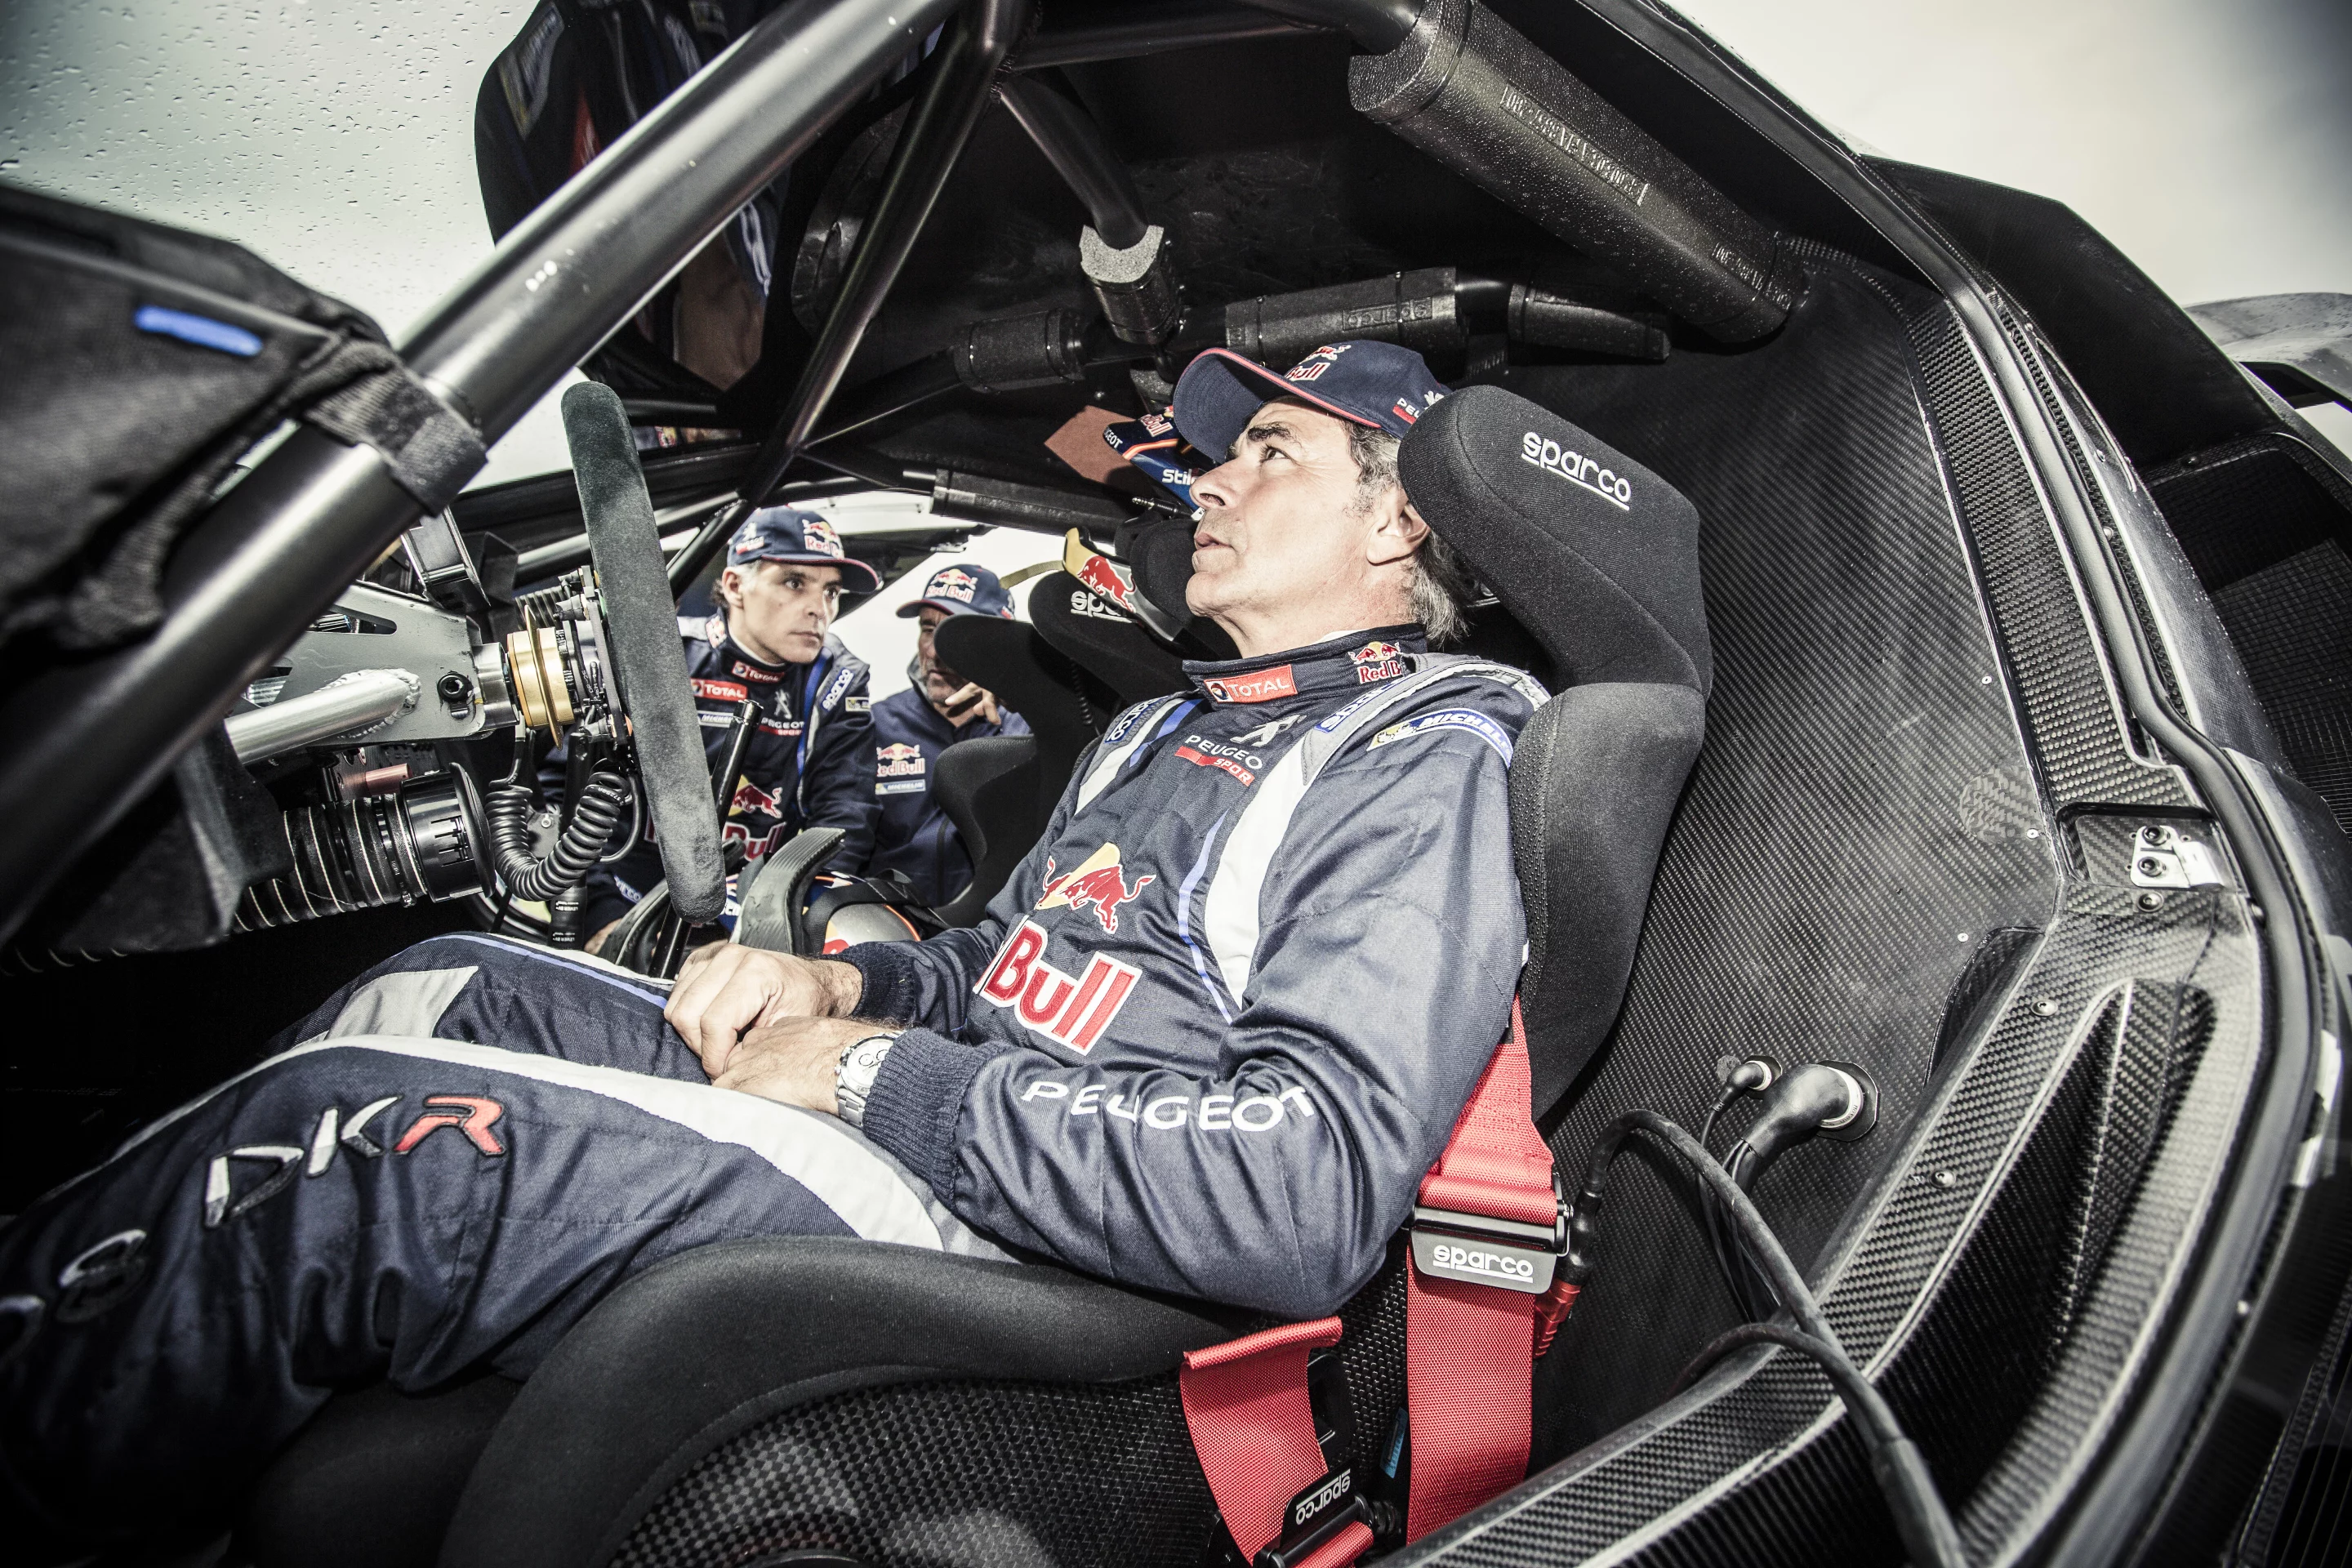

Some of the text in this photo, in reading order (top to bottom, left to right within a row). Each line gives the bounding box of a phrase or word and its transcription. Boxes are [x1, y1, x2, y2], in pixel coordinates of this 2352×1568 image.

[1521, 432, 1631, 510] sparco
[925, 584, 974, 604] Red Bull
[822, 668, 855, 711] sparco
[1357, 658, 1391, 684] Red
[898, 760, 924, 775] Bull
[981, 919, 1137, 1052] Bull
[1021, 1080, 1315, 1132] PEUGEOT
[1432, 1245, 1534, 1284] sparco
[1295, 1468, 1351, 1526] sparco
